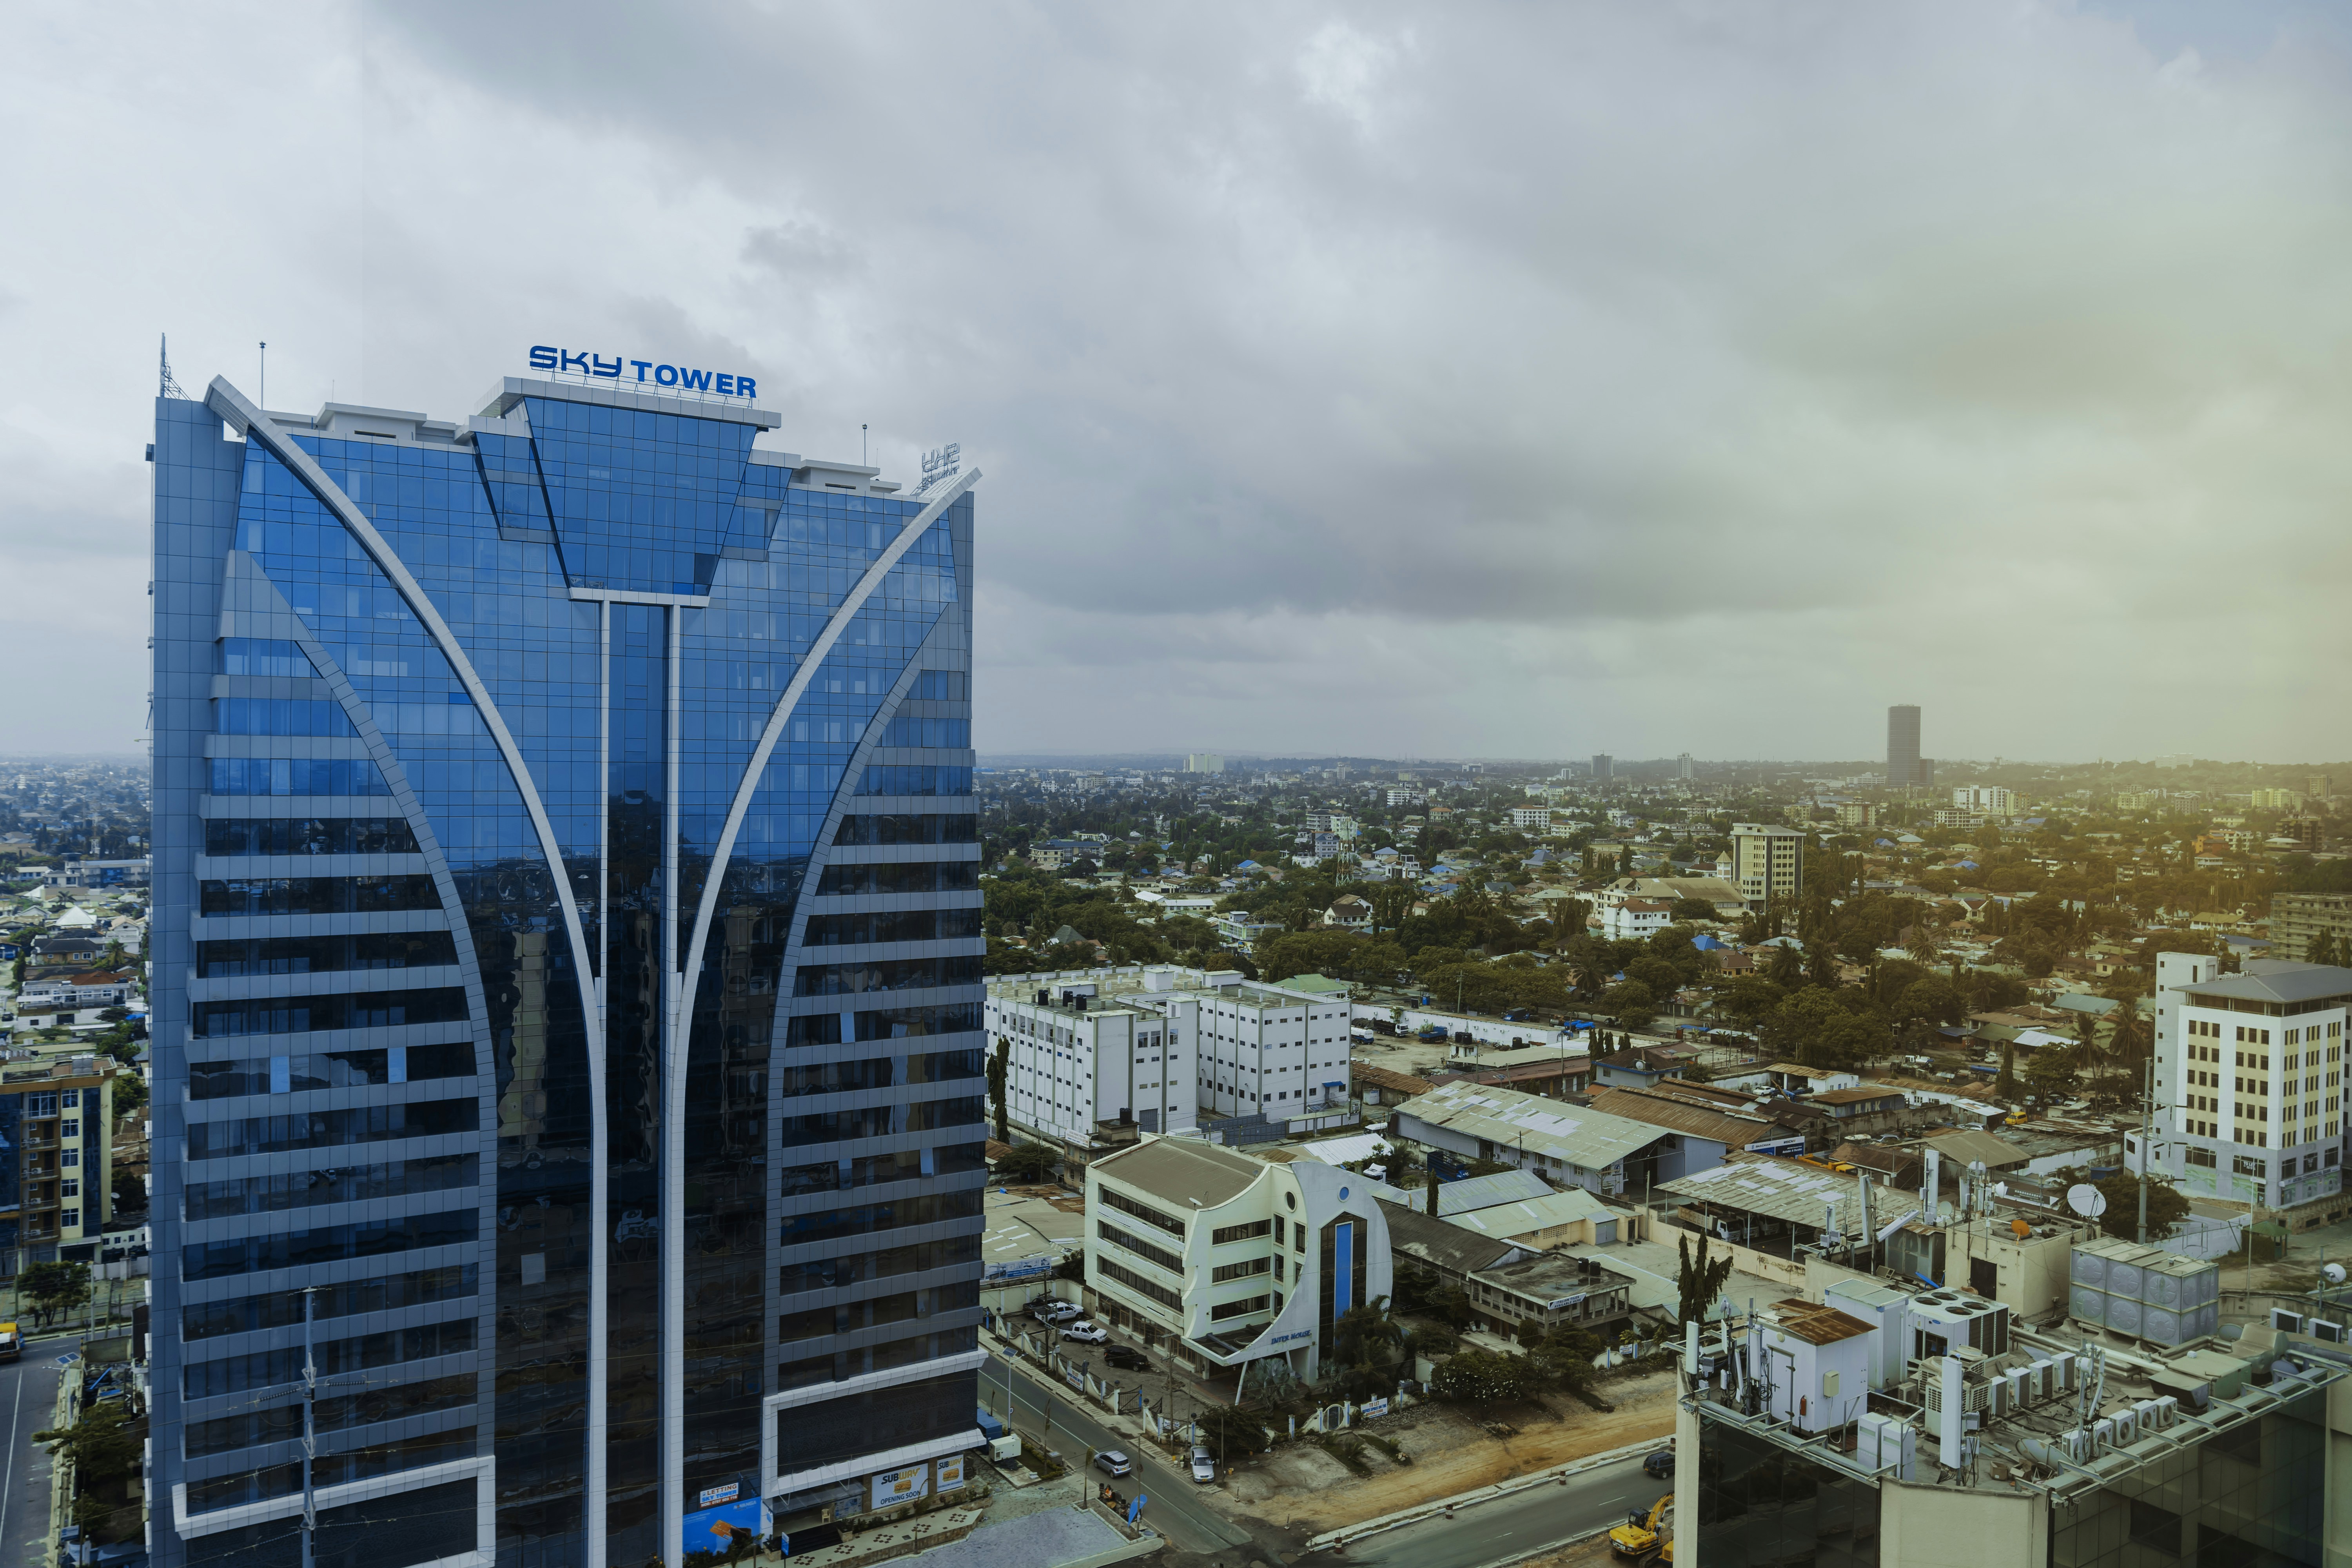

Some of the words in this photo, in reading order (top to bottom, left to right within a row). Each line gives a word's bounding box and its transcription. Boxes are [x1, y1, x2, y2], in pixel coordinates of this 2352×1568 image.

[530, 345, 622, 377] SKY
[630, 360, 756, 398] TOWER
[1271, 1335, 1289, 1345] INTER
[1290, 1330, 1311, 1340] HOUSE
[938, 1457, 962, 1470] SUBWAY
[881, 1468, 920, 1485] SUBWAY
[707, 1484, 737, 1495] LETTING
[717, 1490, 737, 1498] TOWER
[880, 1494, 905, 1505] OPENING
[906, 1490, 921, 1499] SOON
[1613, 1540, 1626, 1550] JCB
